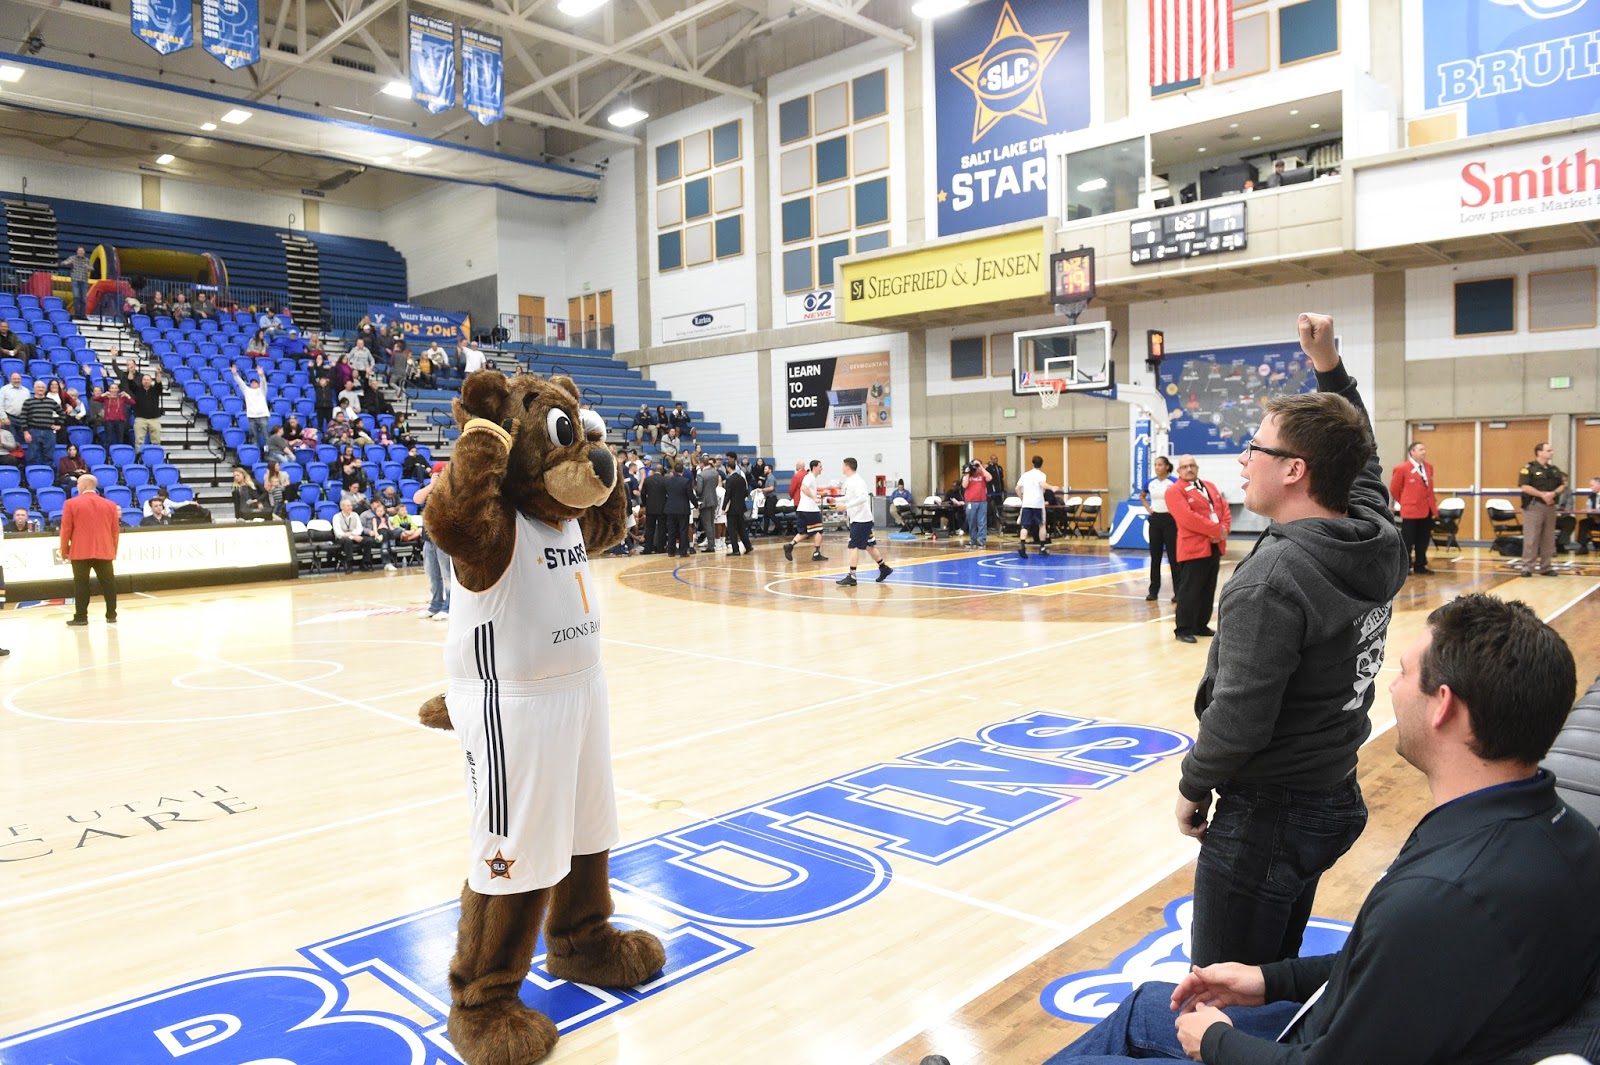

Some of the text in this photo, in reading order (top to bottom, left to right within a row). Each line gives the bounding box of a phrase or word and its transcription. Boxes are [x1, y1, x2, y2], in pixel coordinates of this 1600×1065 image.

[140, 28, 184, 45] SOFTBALL
[210, 44, 251, 60] SOFTBALL
[986, 57, 1029, 91] SLC
[1437, 30, 1600, 106] BRUI
[961, 150, 992, 169] SALT
[994, 141, 1027, 162] LAKE
[1460, 212, 1486, 223] Low
[1541, 196, 1592, 212] Market
[1175, 211, 1205, 232] 6:21
[867, 253, 1041, 300] SIEGFRIED & JENSEN
[818, 291, 832, 311] 2
[419, 314, 433, 322] FAIR
[803, 309, 832, 320] NEWS
[426, 324, 457, 338] ZONE
[789, 364, 821, 378] LEARN
[849, 362, 888, 370] DEVMOUNTAIN
[789, 382, 803, 393] TO
[789, 396, 818, 408] CODE
[575, 571, 589, 614] 1
[552, 622, 589, 644] ZIONS
[66, 785, 228, 824] UTAH
[494, 862, 507, 870] SLC
